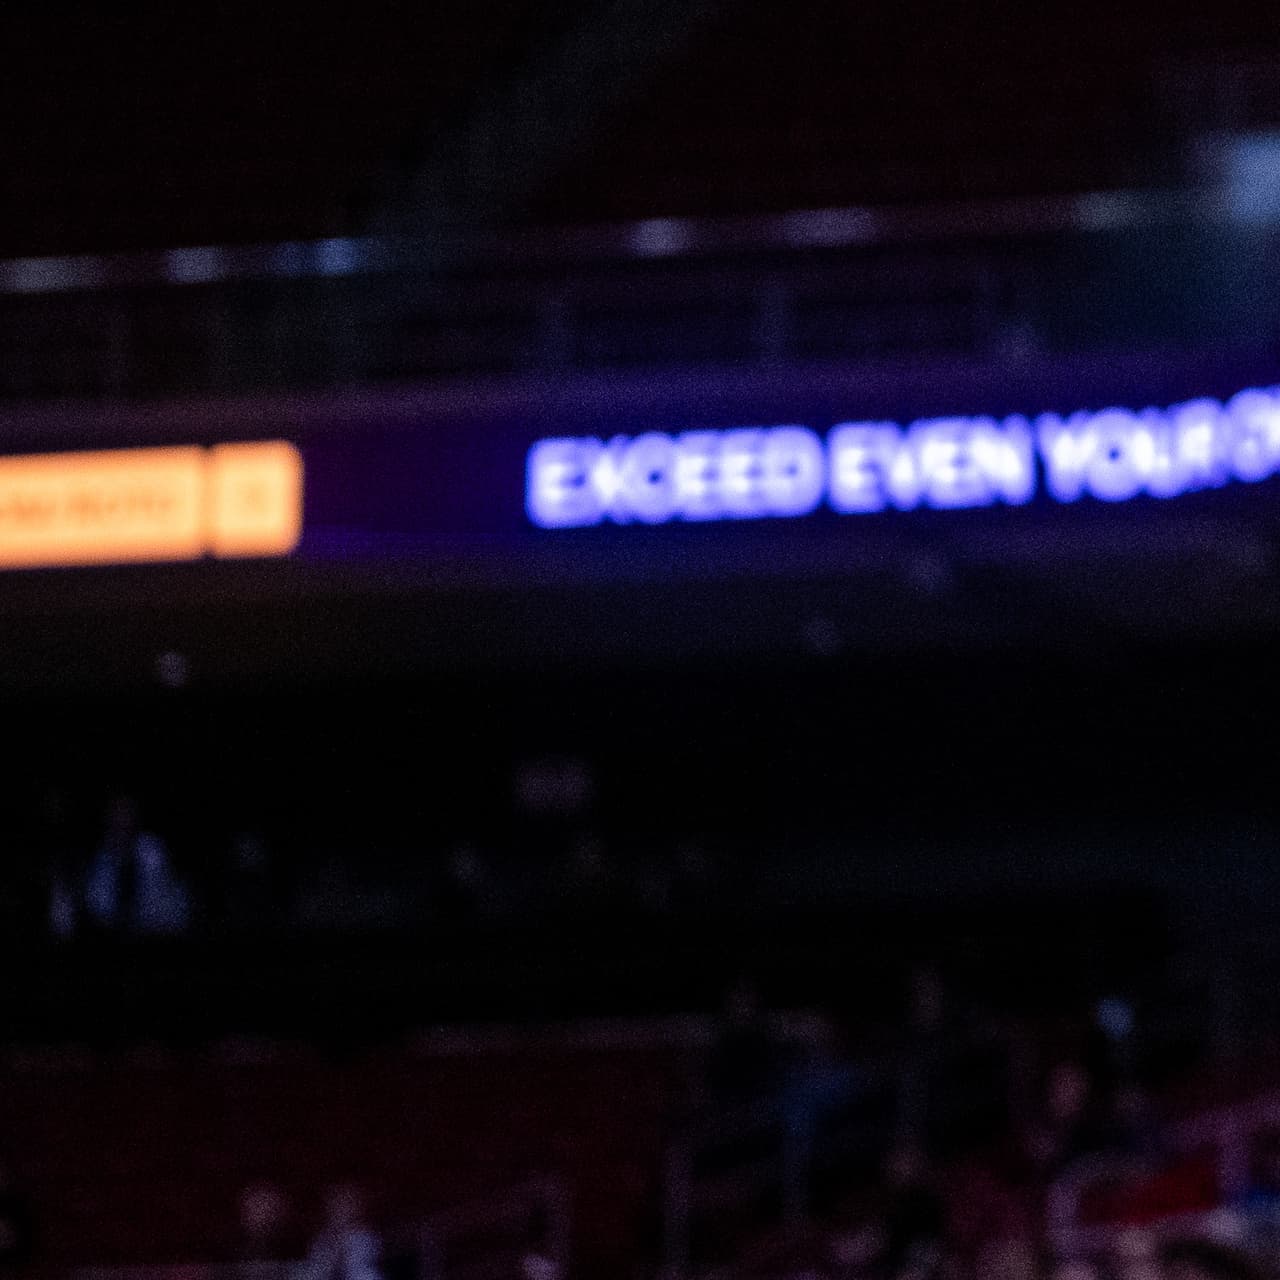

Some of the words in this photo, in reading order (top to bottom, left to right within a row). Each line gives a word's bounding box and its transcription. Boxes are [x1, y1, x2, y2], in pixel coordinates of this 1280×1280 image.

[527, 426, 823, 528] EXCEED
[826, 417, 1036, 513] EVEN
[1036, 397, 1227, 502] YOUR
